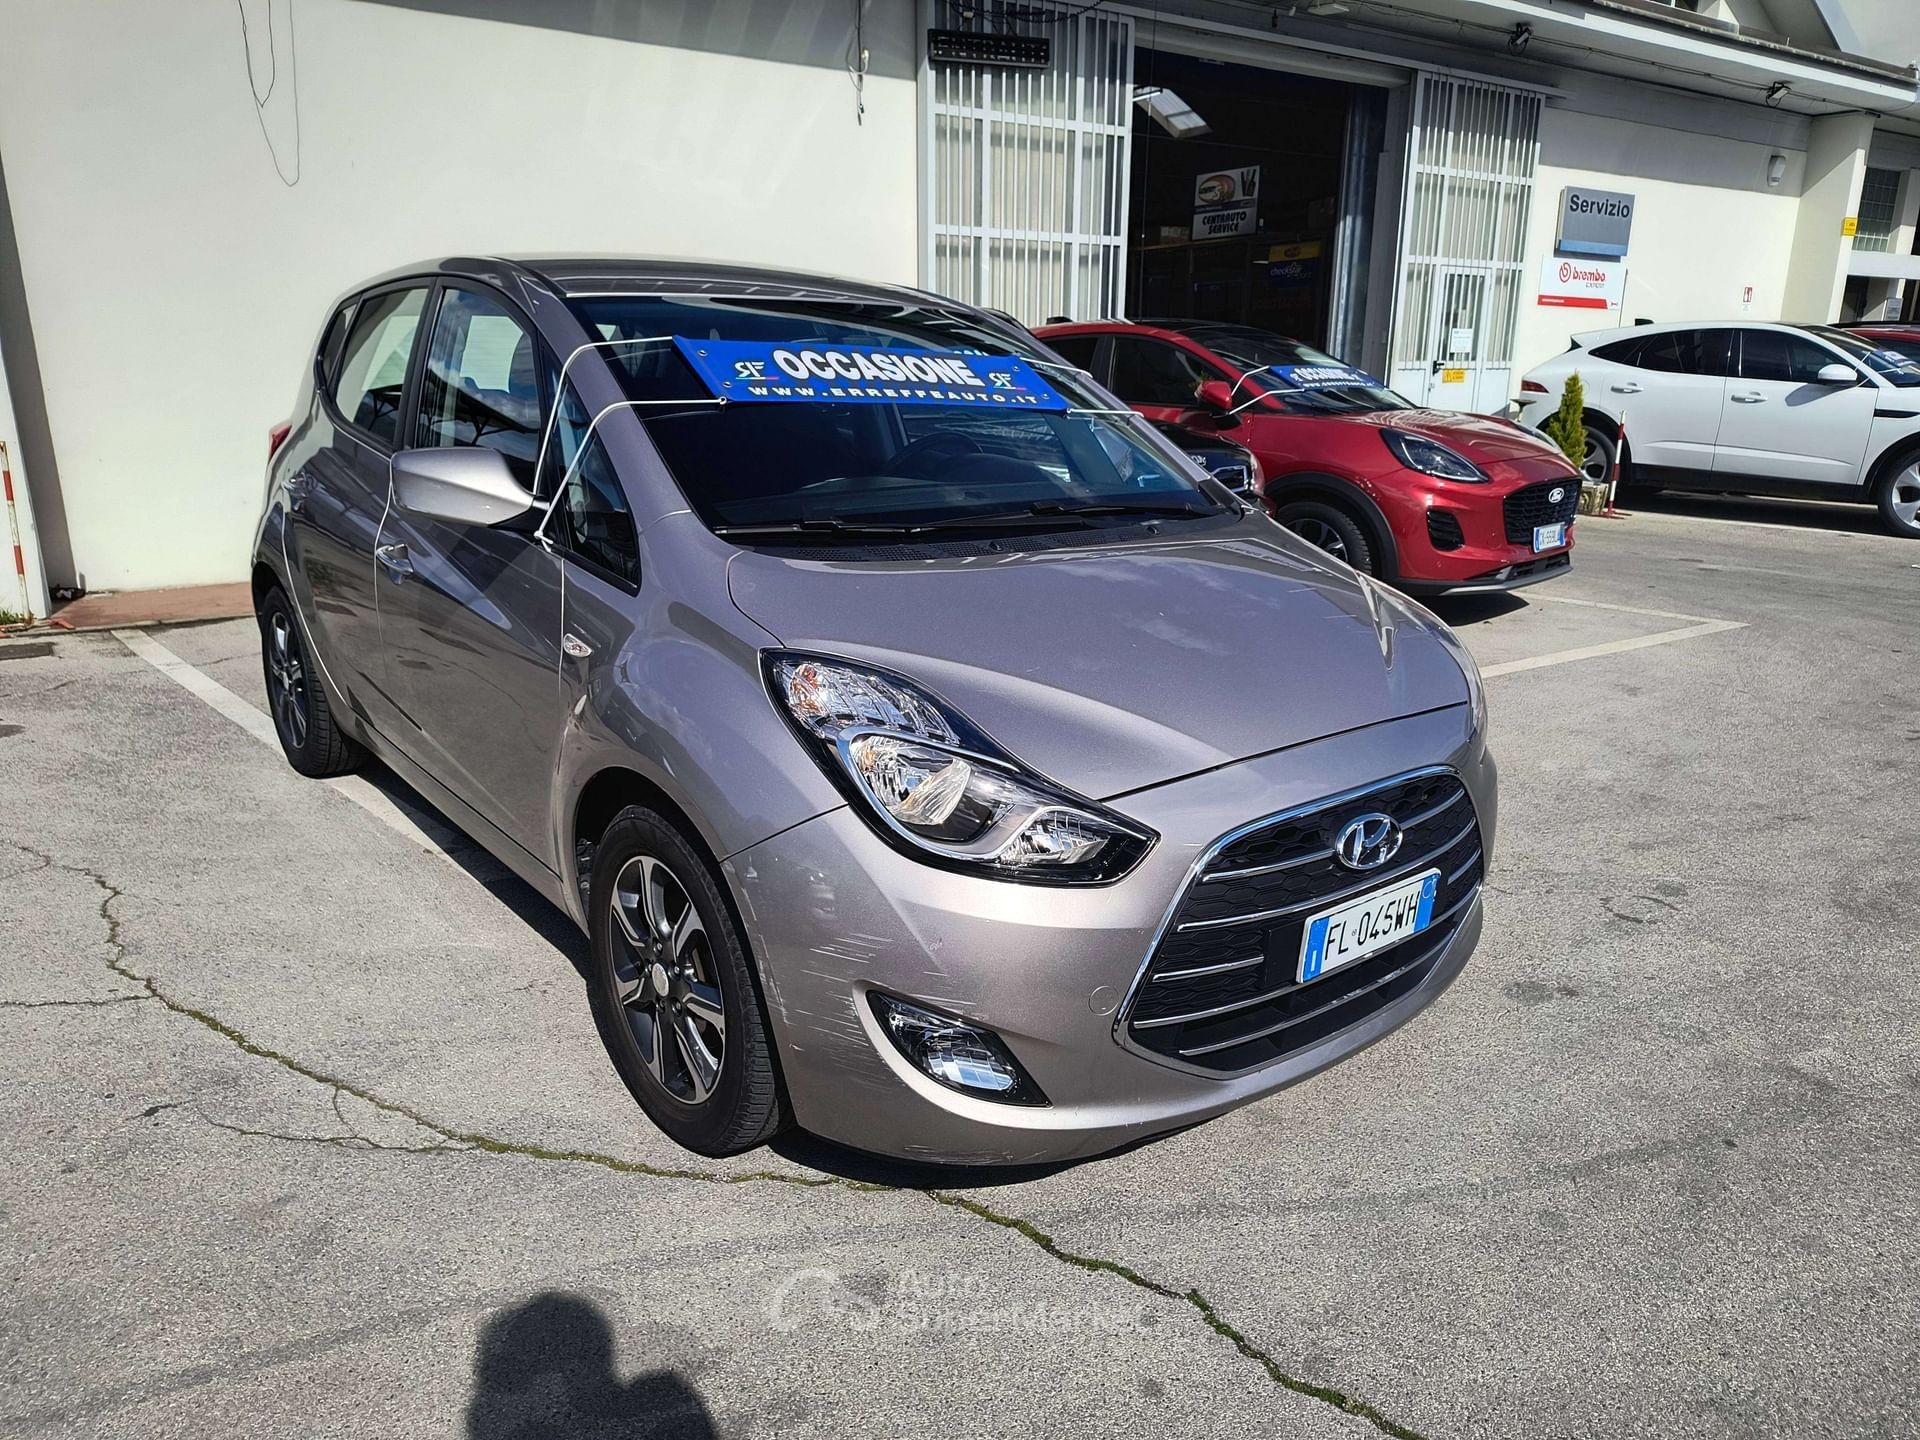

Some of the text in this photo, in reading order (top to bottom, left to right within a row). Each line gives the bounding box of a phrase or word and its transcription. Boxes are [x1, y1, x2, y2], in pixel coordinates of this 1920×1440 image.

[1569, 194, 1630, 218] Servizio
[1202, 211, 1247, 226] CENTRAUTO
[1208, 222, 1239, 235] SERVICE
[1572, 266, 1606, 282] brembo
[773, 349, 985, 387] OCCASIONE
[748, 386, 1039, 404] WWW.ERREFFEAUTO.IT
[1324, 920, 1349, 961] FL
[1357, 890, 1421, 946] 045WH
